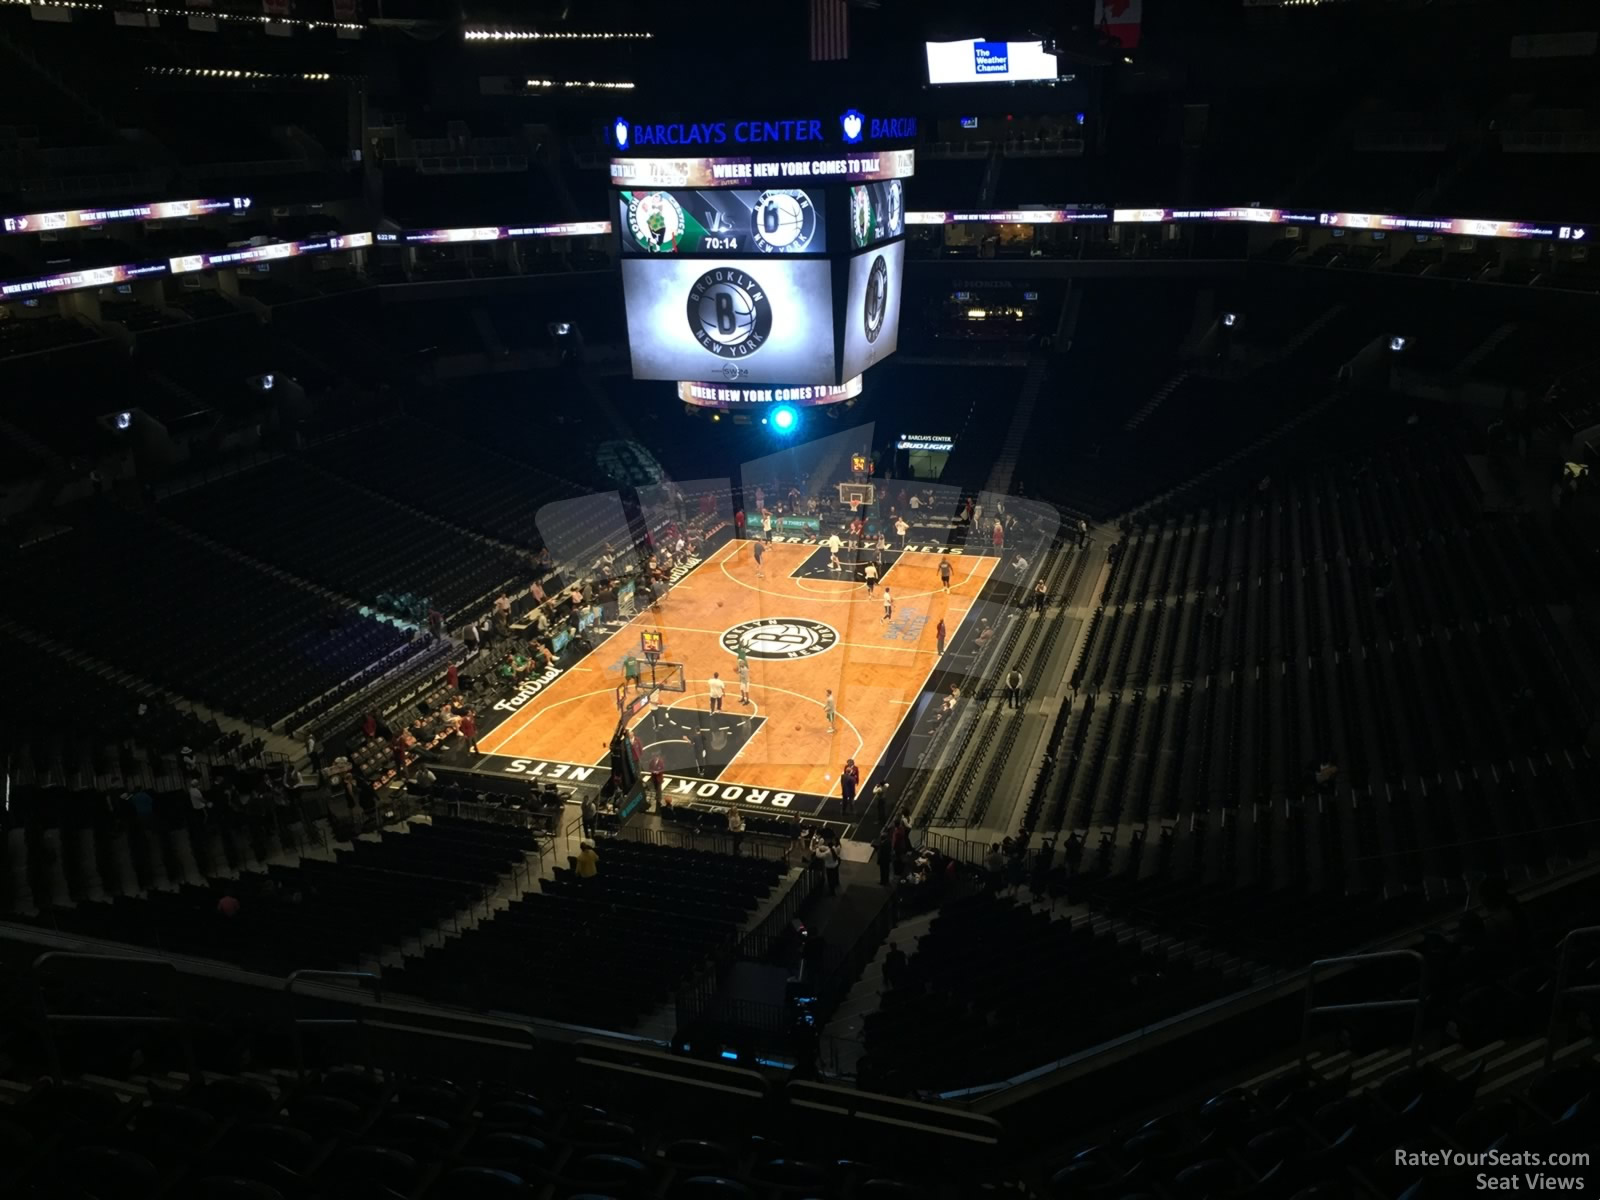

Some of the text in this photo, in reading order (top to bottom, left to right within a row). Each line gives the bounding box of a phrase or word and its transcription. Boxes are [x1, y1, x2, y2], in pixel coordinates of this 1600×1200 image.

[976, 56, 1007, 64] Weather
[977, 64, 1007, 72] Channel
[634, 124, 727, 145] BARCLAYS
[734, 121, 823, 144] CENTER
[713, 158, 880, 178] WHERE NEW YORK COMES TO TALK
[628, 197, 646, 240] BOSTON
[705, 237, 737, 249] 70:14
[754, 232, 807, 253] NEW YORK
[690, 270, 764, 302] BROOKLYN
[715, 292, 737, 335] B
[696, 329, 763, 357] NEW YORK
[690, 384, 847, 402] WHERE NEW YORK COMES TO TALK
[904, 544, 964, 555] NETS
[644, 640, 659, 650] 24
[751, 632, 808, 645] B
[787, 624, 834, 659] NEW YORK
[493, 665, 563, 712] FanDuel
[505, 759, 594, 781] NETS
